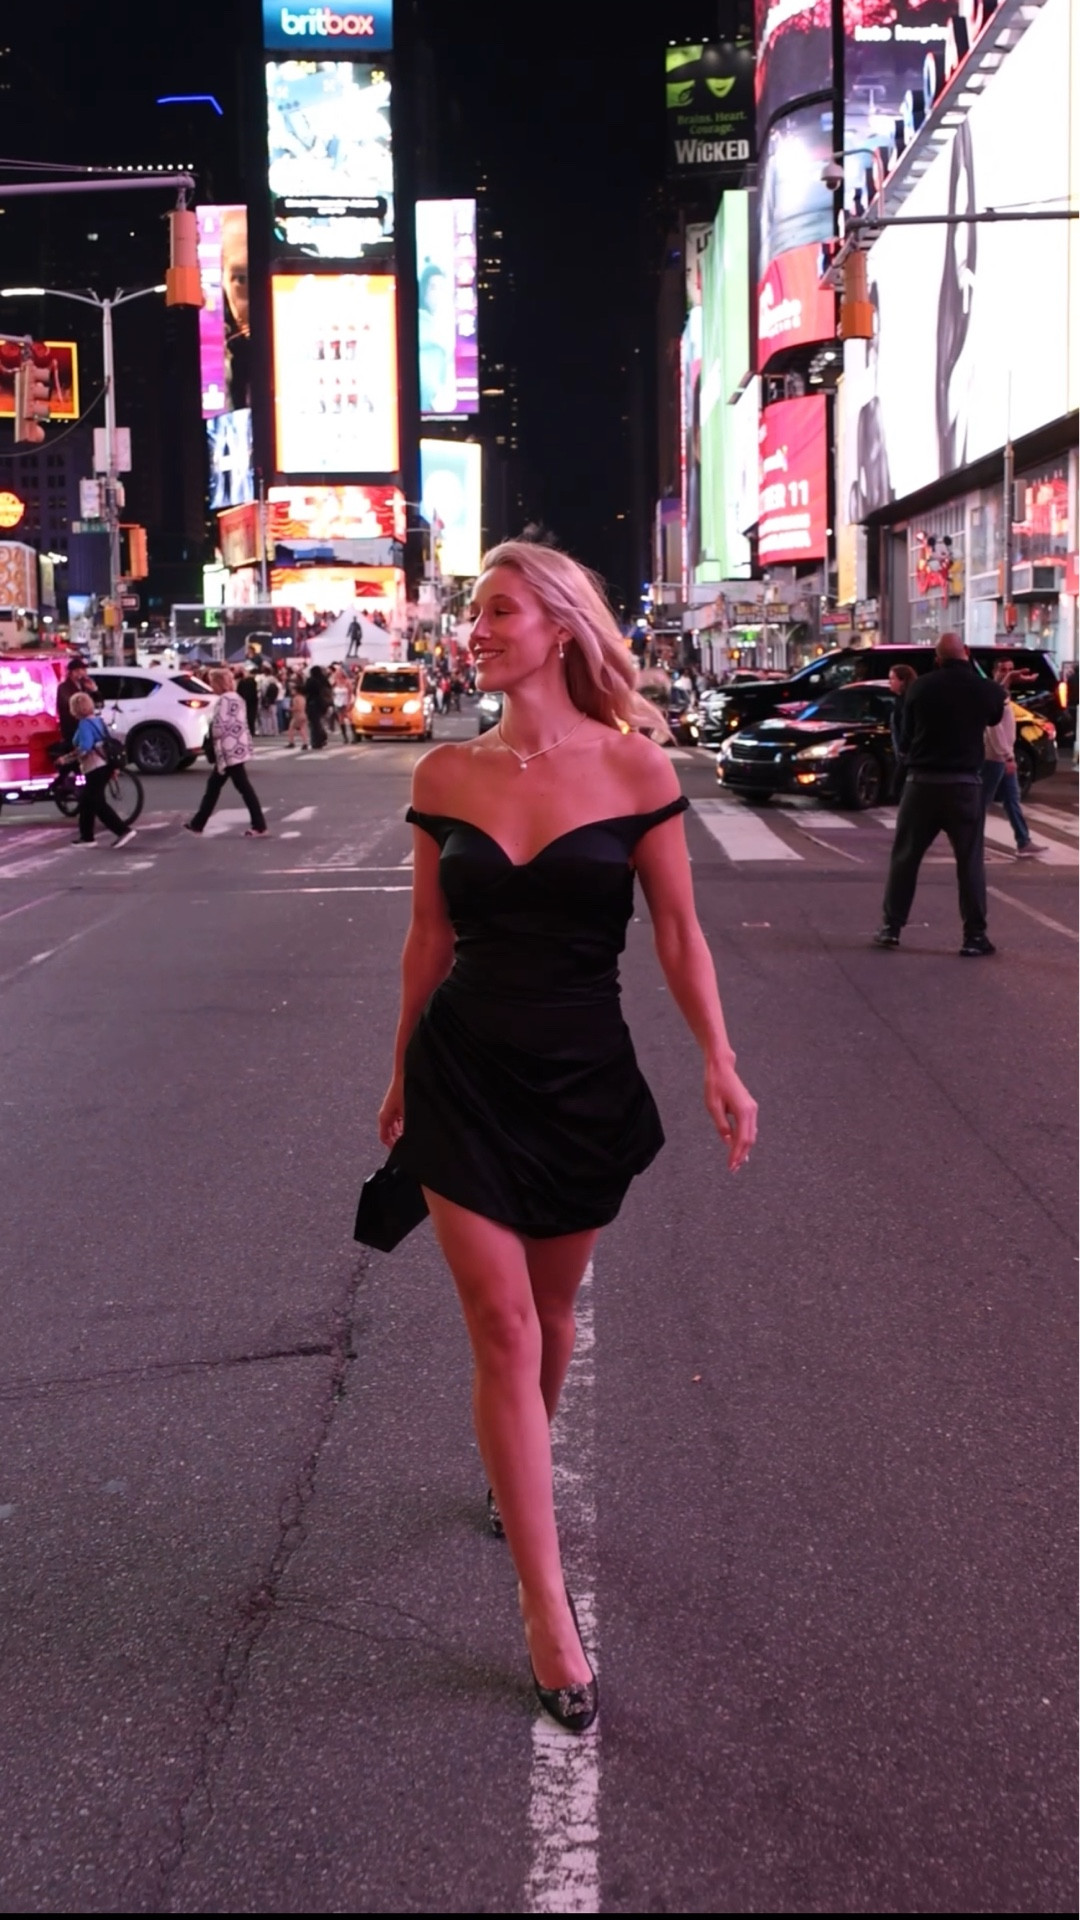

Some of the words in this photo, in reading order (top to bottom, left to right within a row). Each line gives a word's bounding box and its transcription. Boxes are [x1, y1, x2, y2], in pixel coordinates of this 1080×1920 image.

[281, 7, 375, 36] britbox
[677, 114, 713, 125] Brains.
[715, 111, 747, 122] Heart.
[689, 123, 736, 136] Courage.
[788, 479, 809, 507] 11
